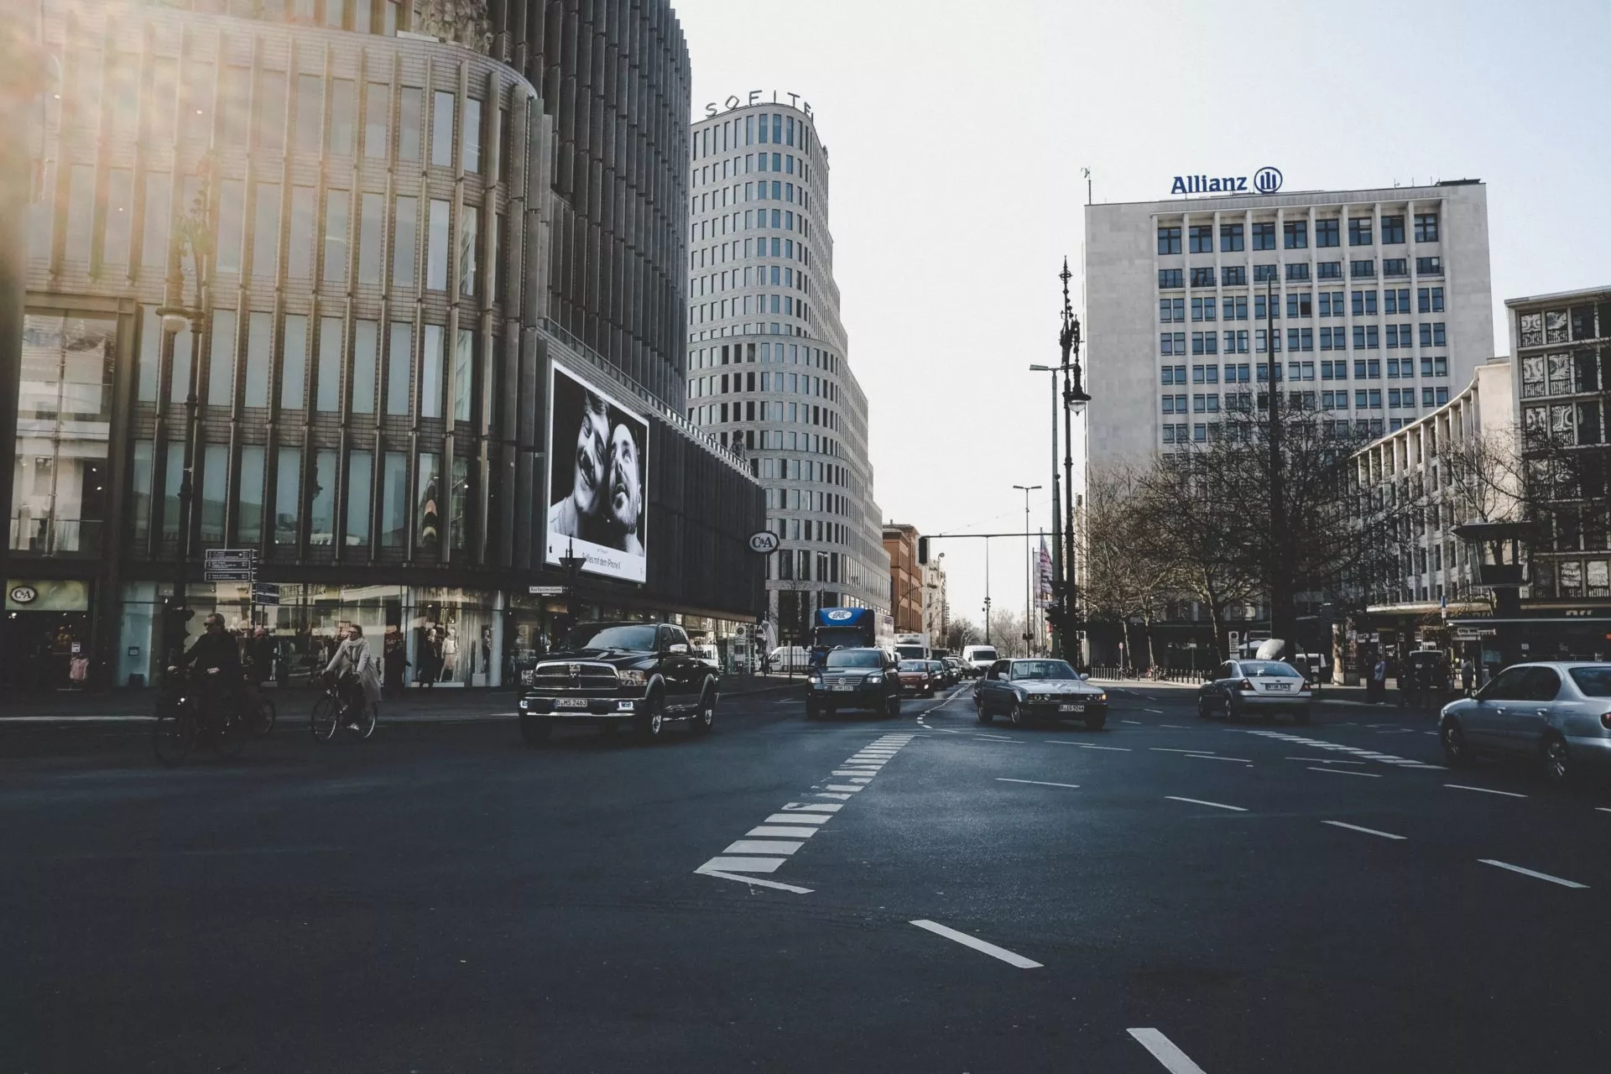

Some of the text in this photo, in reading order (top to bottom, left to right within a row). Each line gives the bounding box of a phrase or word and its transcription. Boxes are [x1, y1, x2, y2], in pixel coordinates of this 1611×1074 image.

[1171, 175, 1247, 194] Allianz
[752, 536, 773, 548] C&A
[14, 590, 31, 599] C&A
